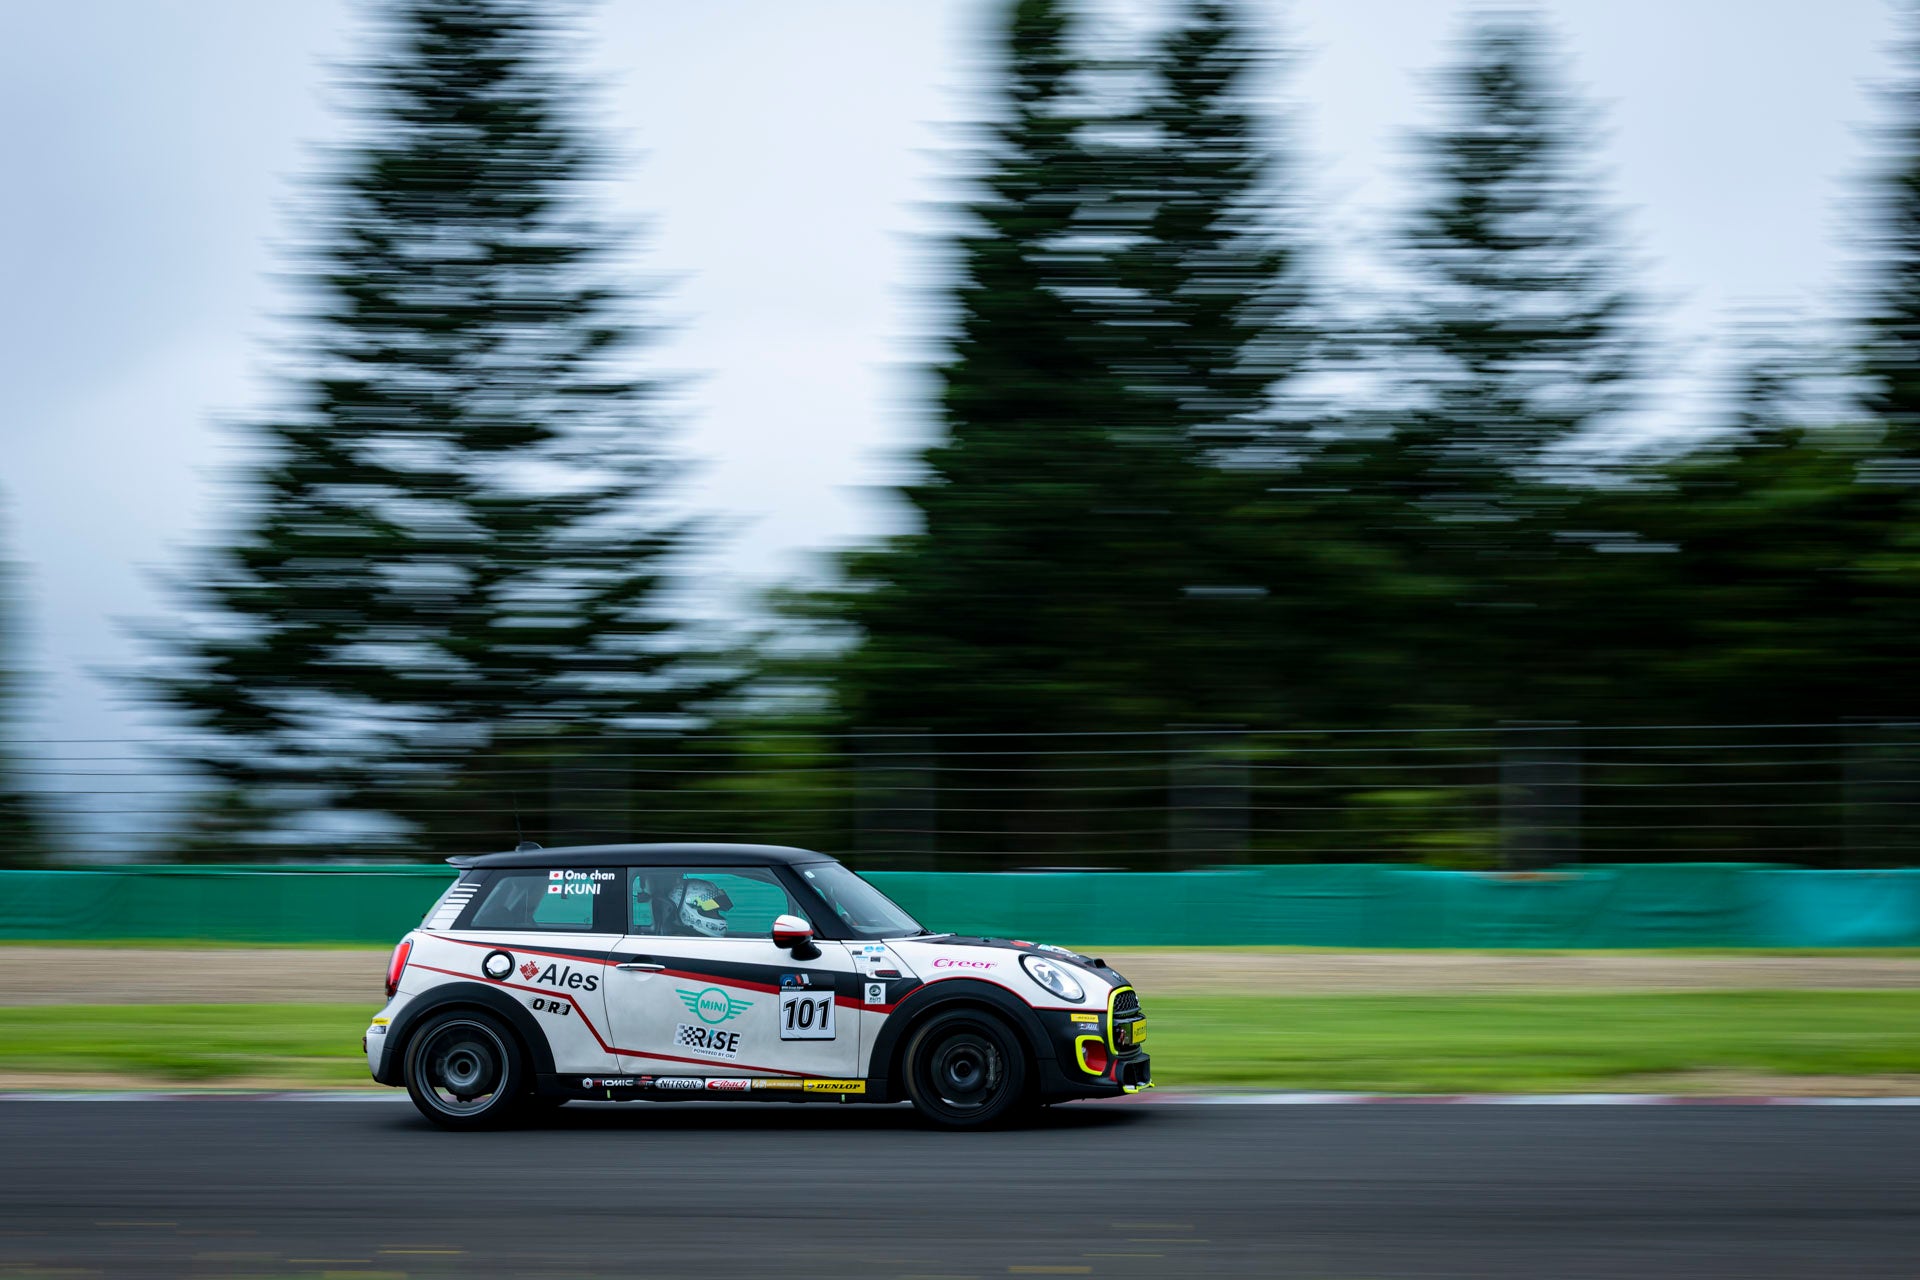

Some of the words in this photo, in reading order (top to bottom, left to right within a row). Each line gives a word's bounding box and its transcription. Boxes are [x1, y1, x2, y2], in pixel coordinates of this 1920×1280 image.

[565, 870, 587, 880] One
[590, 869, 615, 880] chan
[564, 883, 601, 894] KUNI
[933, 958, 998, 969] Creer
[537, 963, 599, 991] Ales
[532, 998, 571, 1016] ORJ
[700, 999, 726, 1012] MINI
[783, 997, 832, 1030] 101
[694, 1027, 740, 1052] RISE
[693, 1048, 717, 1056] POWERED
[602, 1079, 634, 1087] IOMIC
[660, 1080, 697, 1089] NITRON
